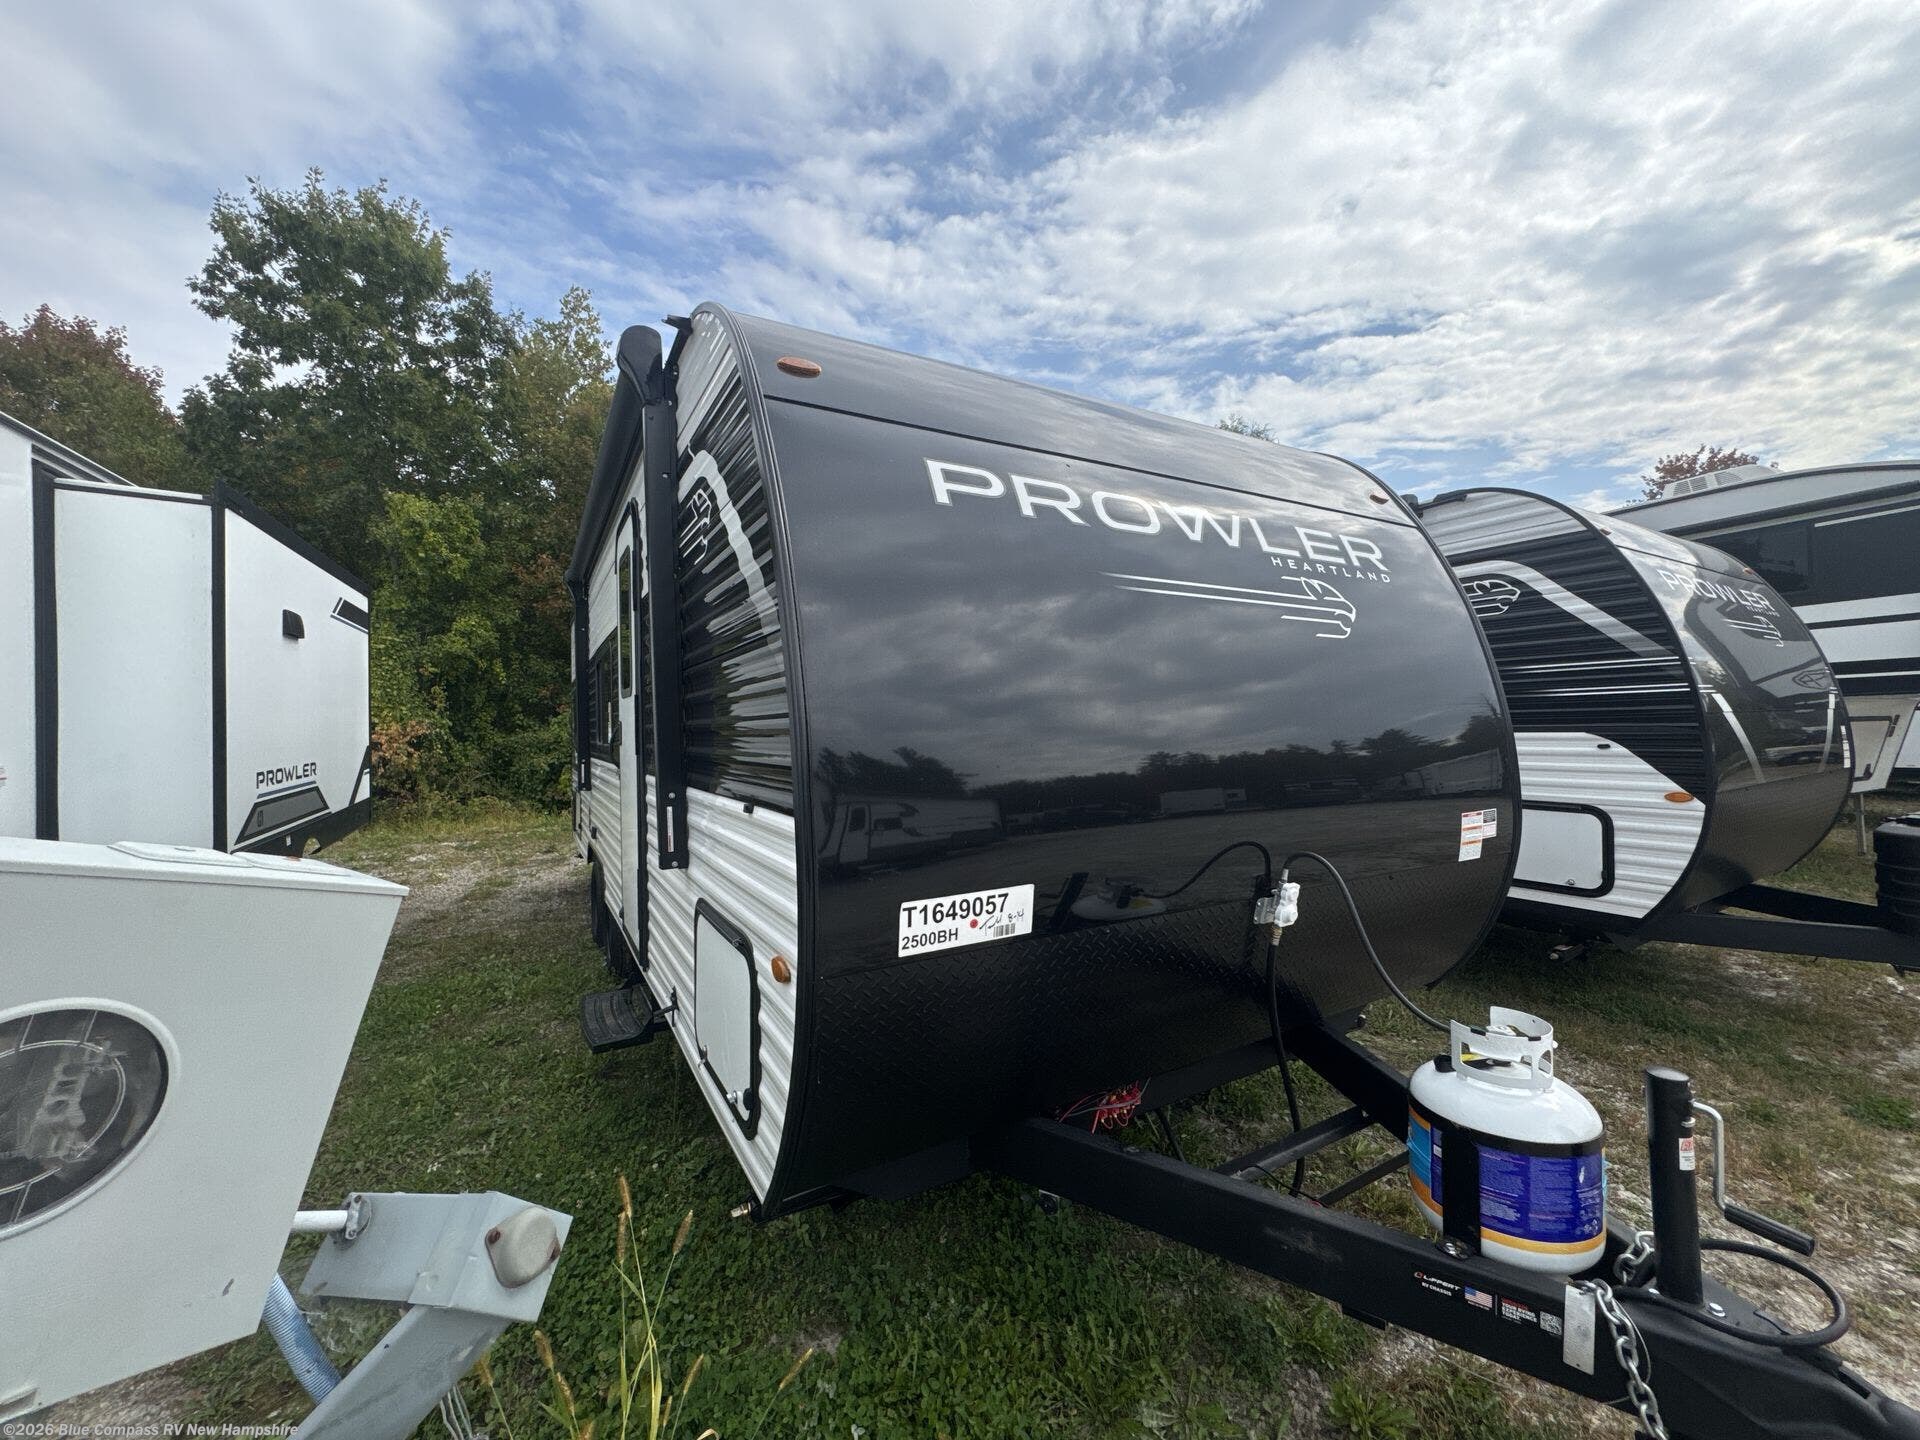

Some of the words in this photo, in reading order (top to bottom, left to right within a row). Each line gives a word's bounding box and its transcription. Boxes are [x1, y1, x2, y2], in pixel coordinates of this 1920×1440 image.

[924, 457, 1390, 572] PROWLER
[1271, 556, 1391, 583] HEARTLAND
[1656, 569, 1776, 611] PROWLER
[256, 762, 317, 789] PROWLER
[902, 892, 1009, 928] T1649057
[901, 927, 959, 950] 2500BH
